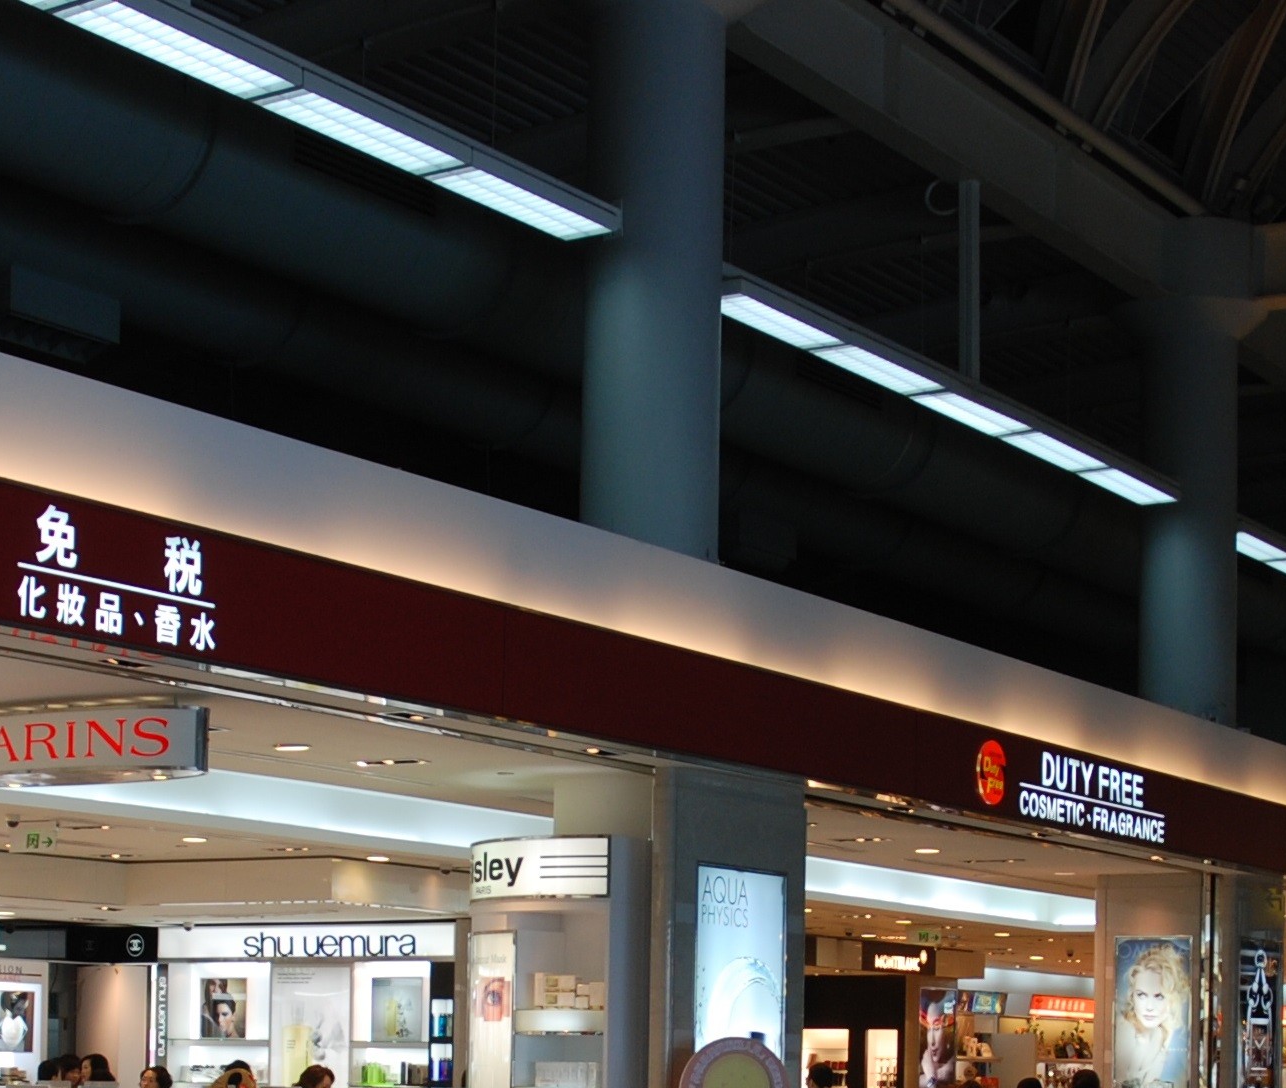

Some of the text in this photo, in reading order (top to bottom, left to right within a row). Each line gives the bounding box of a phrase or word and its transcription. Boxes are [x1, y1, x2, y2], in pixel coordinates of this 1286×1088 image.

[36, 504, 78, 569] 免
[1041, 751, 1144, 808] DUTY FREE
[702, 875, 749, 906] AQUA
[701, 904, 749, 929] PHYSICS
[243, 931, 417, 958] shu uemura
